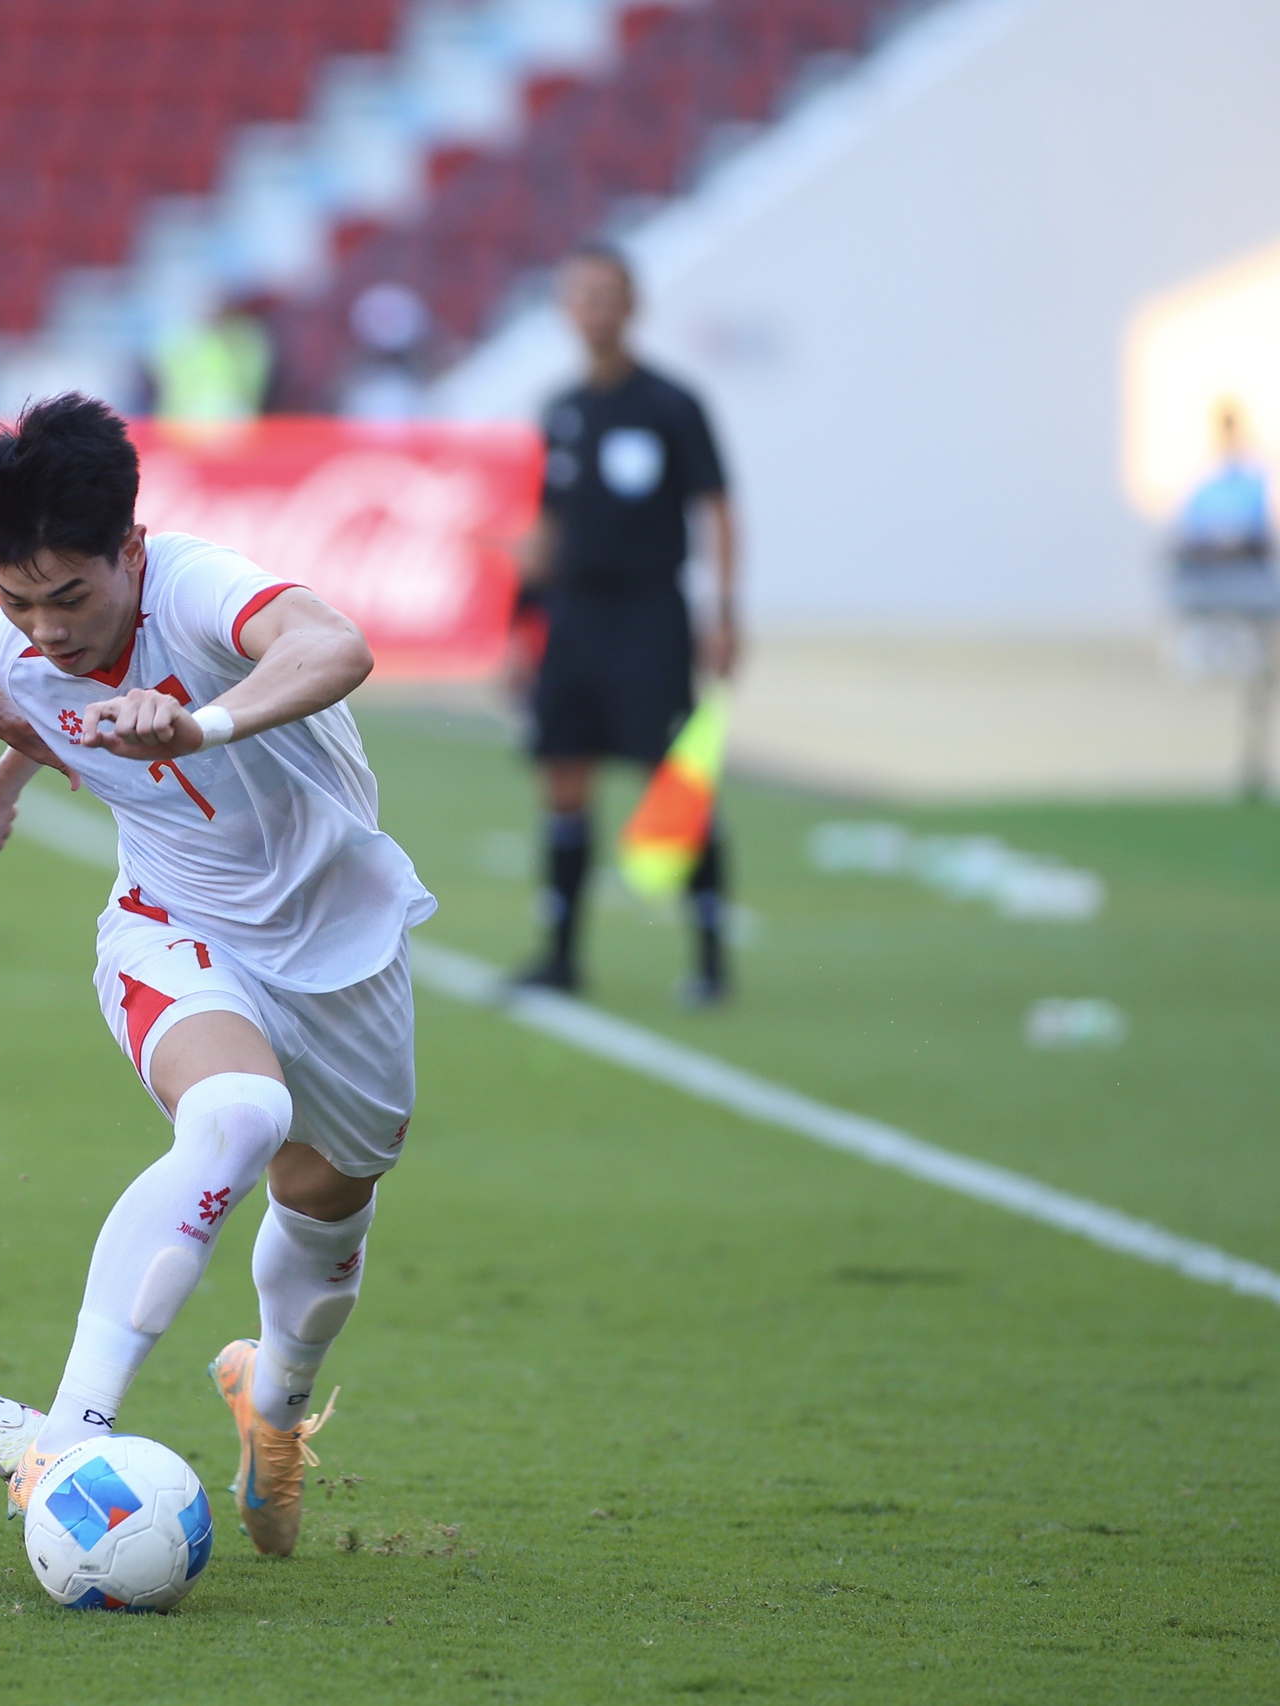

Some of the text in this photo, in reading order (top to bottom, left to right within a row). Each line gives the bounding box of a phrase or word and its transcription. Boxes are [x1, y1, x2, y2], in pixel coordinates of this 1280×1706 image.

[148, 759, 216, 821] 7
[166, 938, 212, 969] 7
[39, 1446, 83, 1485] molten
